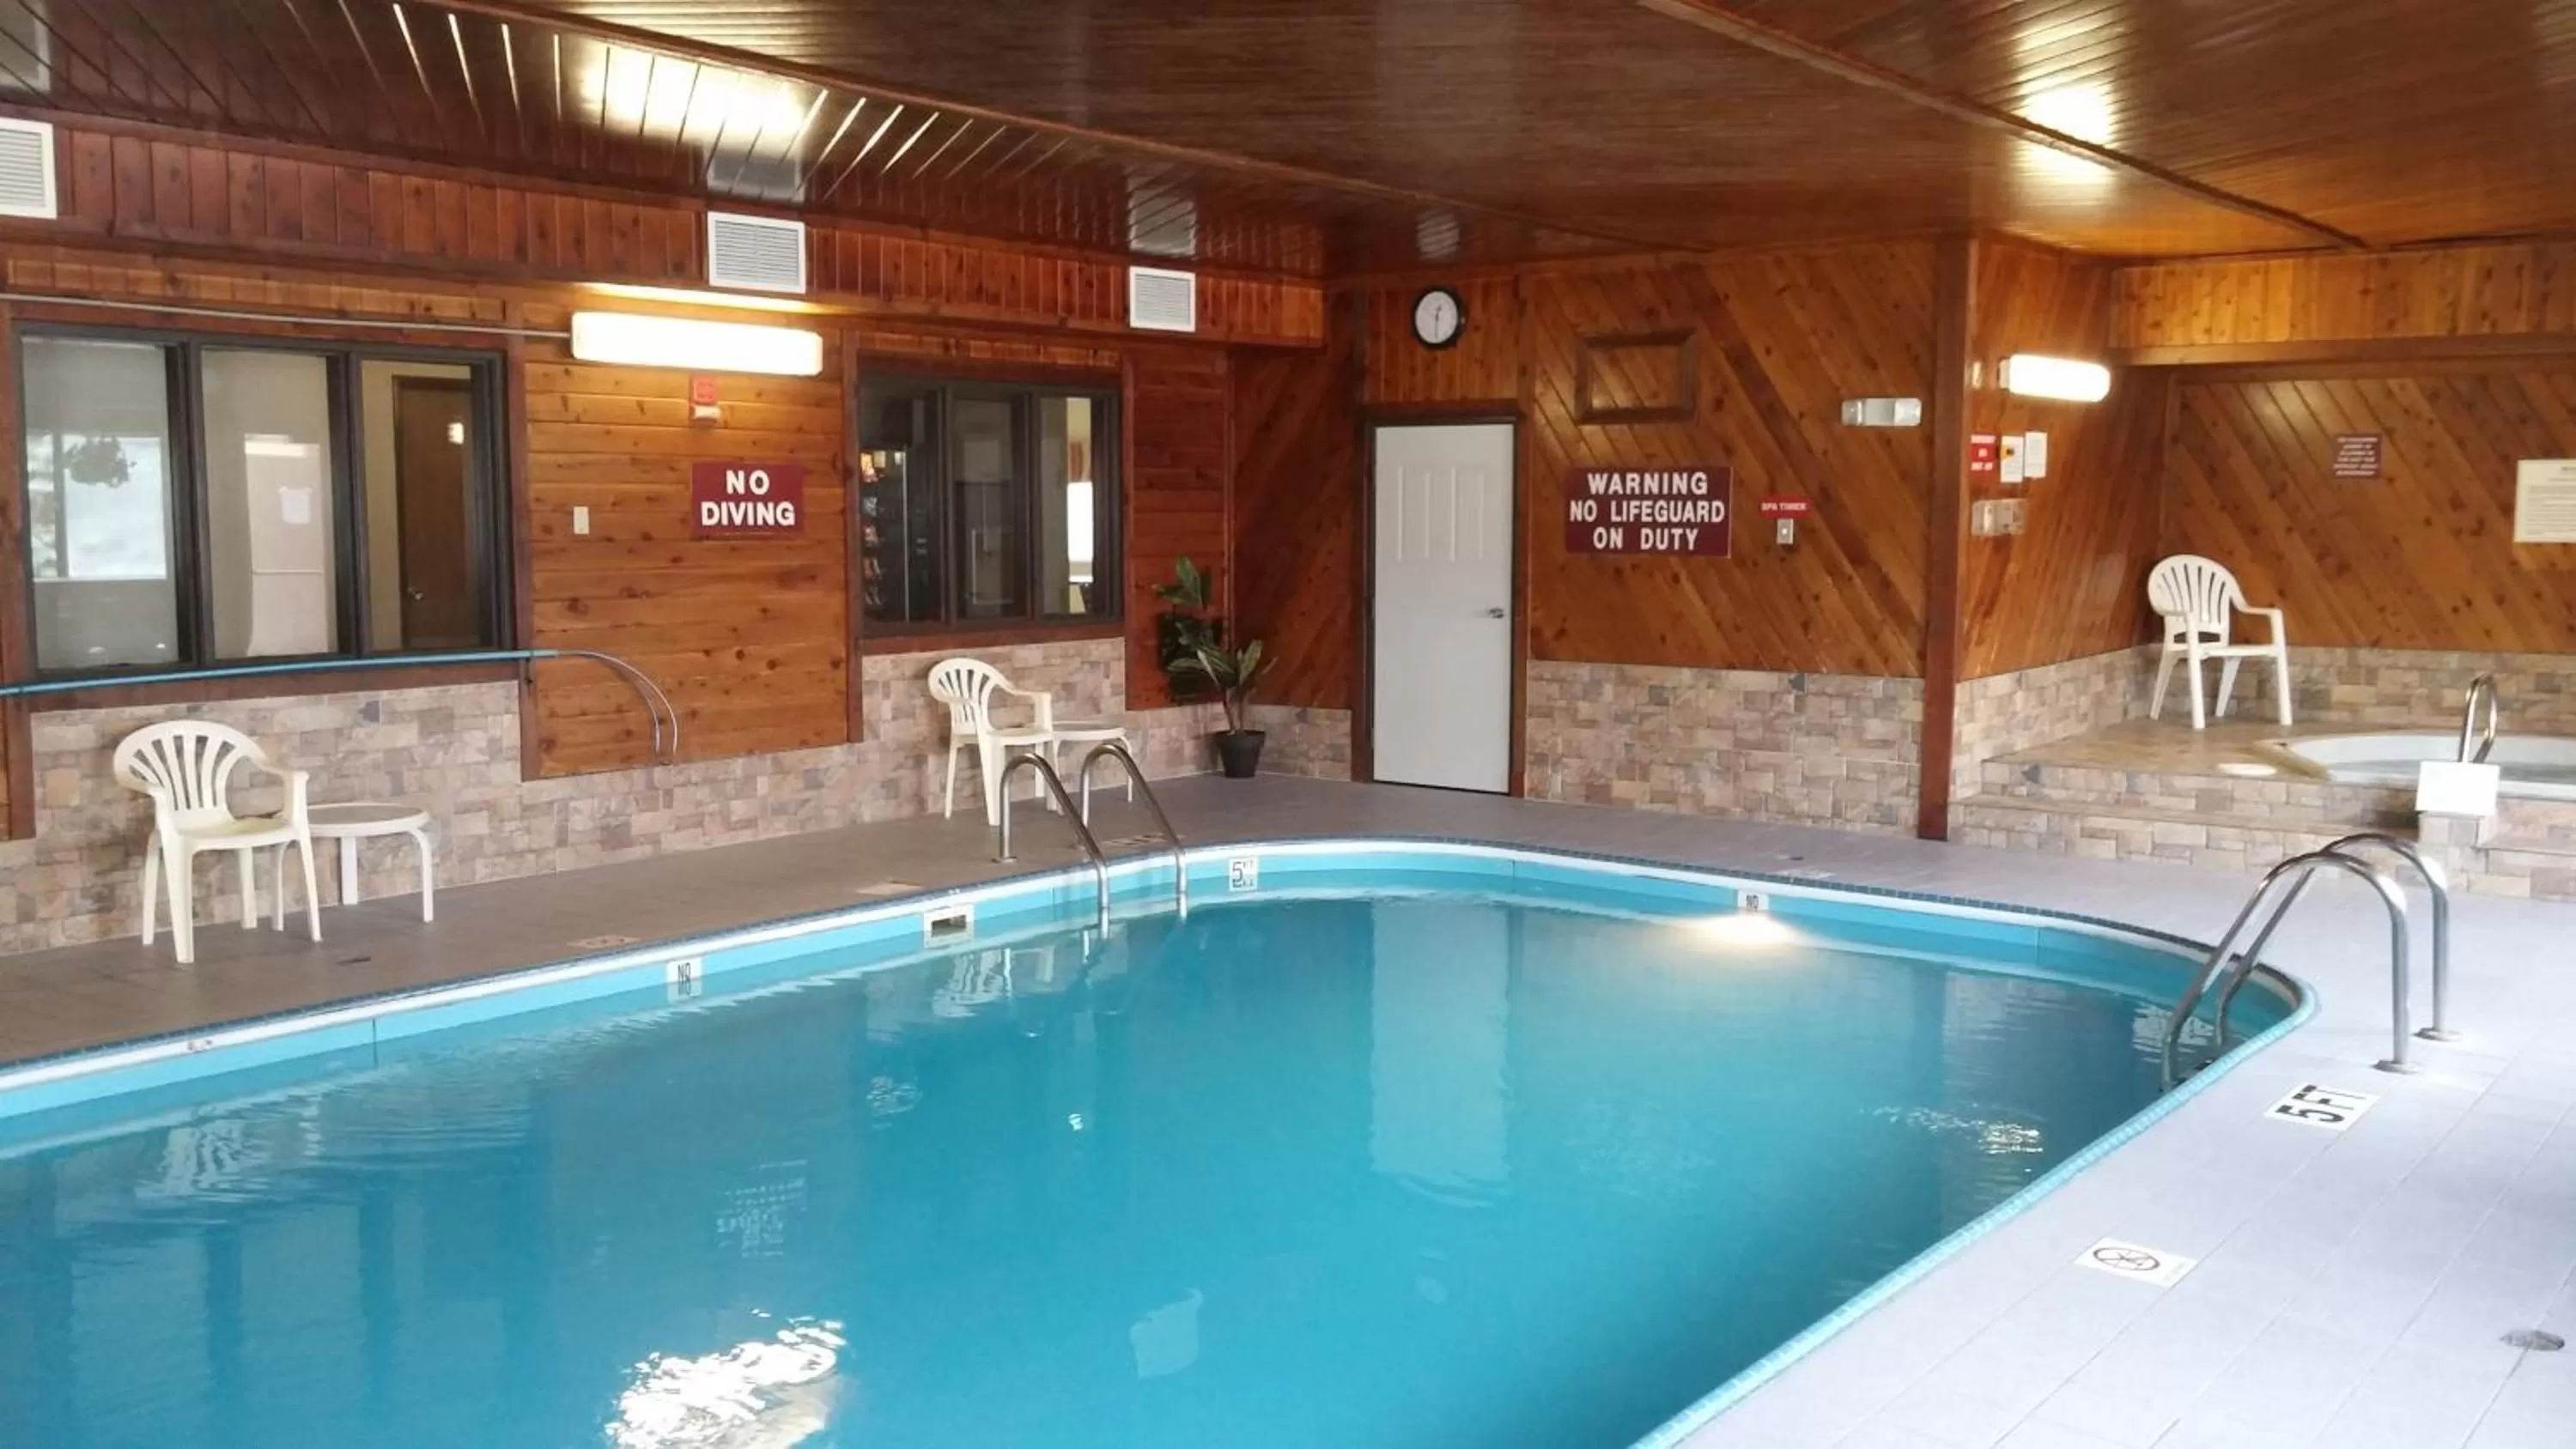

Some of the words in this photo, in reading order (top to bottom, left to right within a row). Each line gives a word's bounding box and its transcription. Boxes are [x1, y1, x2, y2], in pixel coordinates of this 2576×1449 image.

[726, 469, 770, 495] NO
[1587, 471, 1708, 495] WARNING
[701, 500, 795, 526] DIVING
[1569, 499, 1598, 523] NO
[1610, 499, 1726, 523] LIFEGUARD
[1593, 526, 1624, 549] ON
[1640, 527, 1698, 550] DUTY
